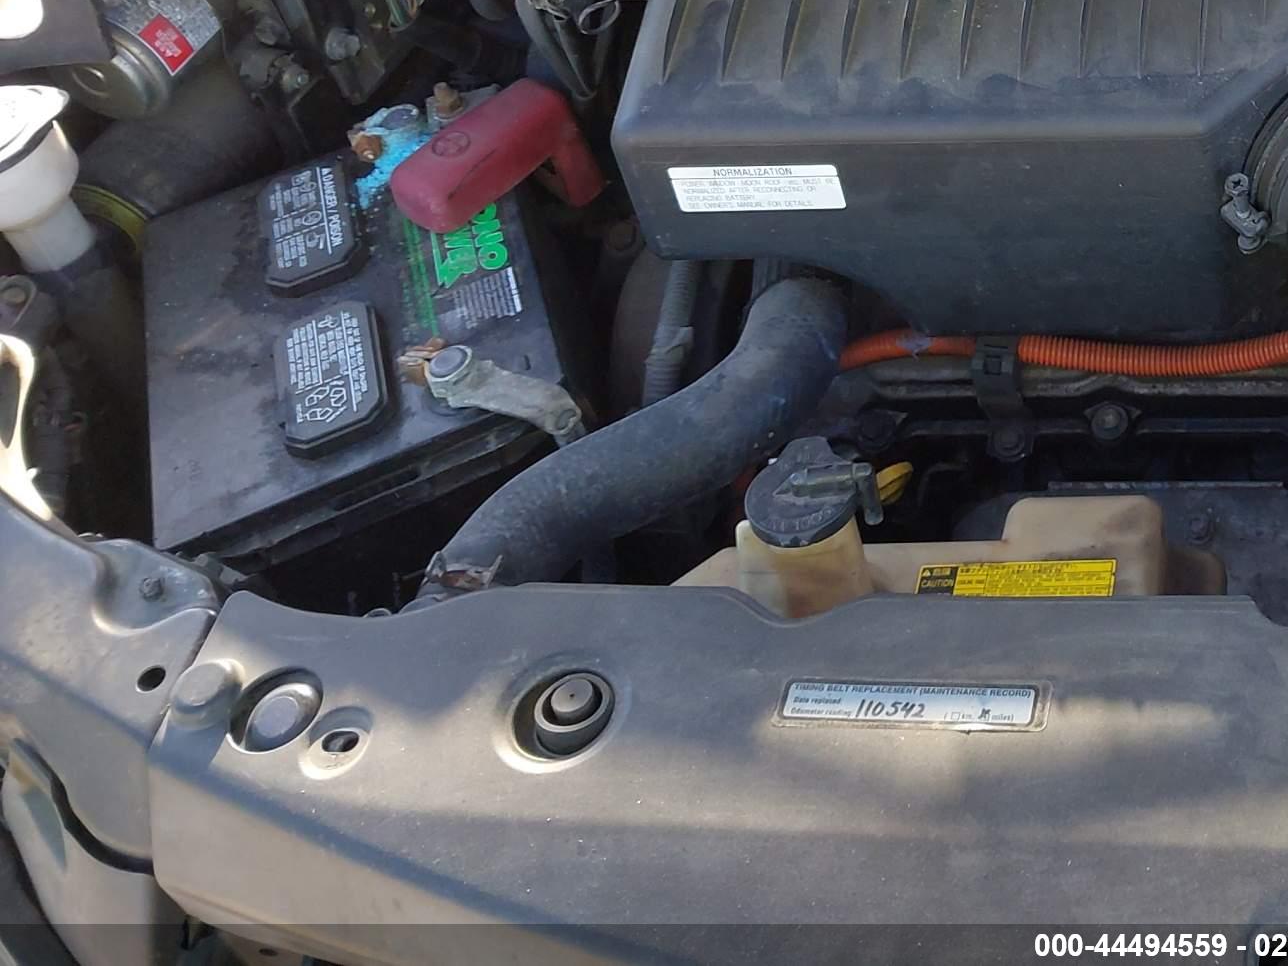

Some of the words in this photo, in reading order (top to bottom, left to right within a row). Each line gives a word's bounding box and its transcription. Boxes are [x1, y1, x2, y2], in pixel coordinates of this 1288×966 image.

[713, 167, 793, 177] NORMALIZATION
[321, 174, 338, 209] DANGER
[328, 213, 344, 247] POISON
[921, 579, 954, 588] CAUTION
[795, 684, 825, 692] TIMING
[851, 685, 918, 694] REPLACEMENT
[920, 687, 987, 696] (MAINTENANCE
[990, 689, 1031, 698] RECORD)
[855, 699, 925, 718] 110542
[992, 714, 1014, 722] miles)
